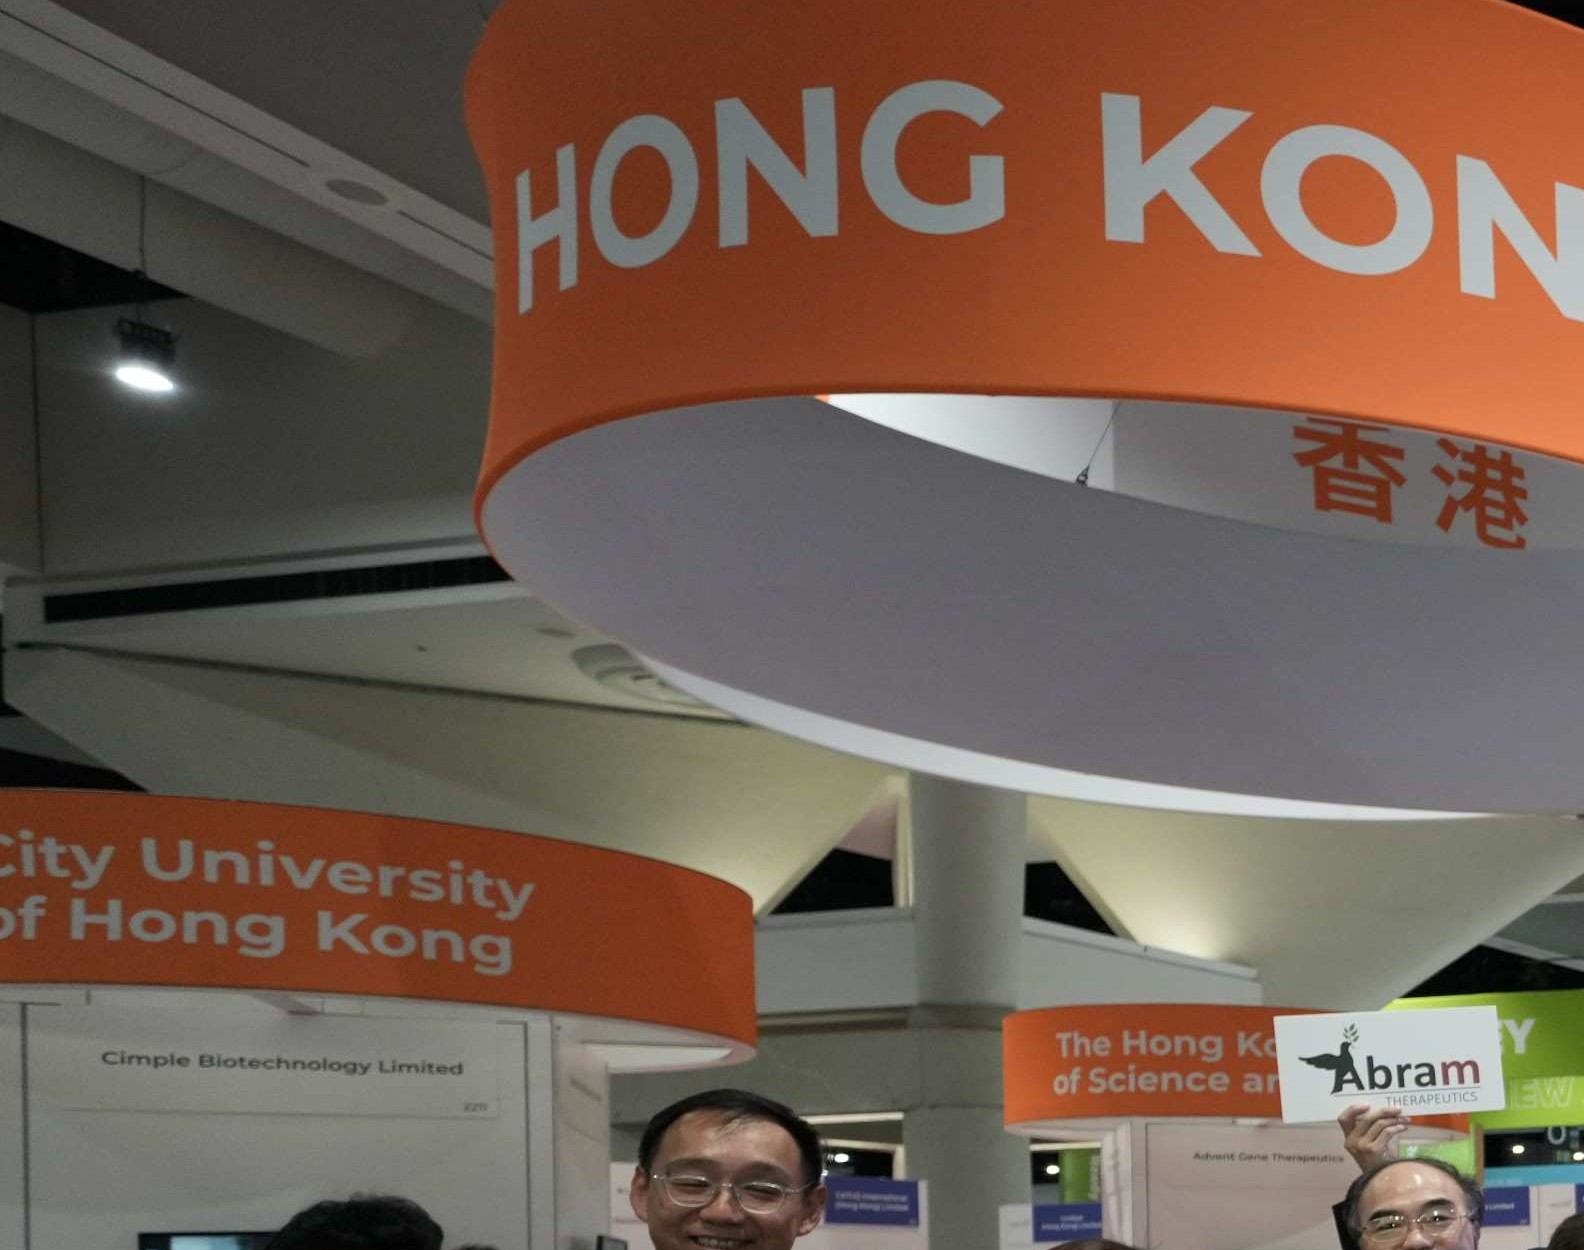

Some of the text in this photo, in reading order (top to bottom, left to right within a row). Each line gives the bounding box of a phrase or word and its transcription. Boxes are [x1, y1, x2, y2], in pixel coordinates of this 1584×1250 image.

[515, 79, 1006, 315] HONG
[1292, 417, 1530, 550] 香港
[141, 836, 535, 921] University
[71, 898, 285, 959] Hong
[317, 910, 513, 976] Kong
[101, 1051, 464, 1076] Cimple Biotechnology Limited
[1056, 1031, 1111, 1059] The
[1122, 1030, 1224, 1063] Hong
[1053, 1066, 1280, 1096] of Science an
[1331, 1055, 1481, 1095] Abram
[1385, 1092, 1479, 1107] THERAPEUTICS
[1193, 1151, 1344, 1163] Advent Gene Therapeutics
